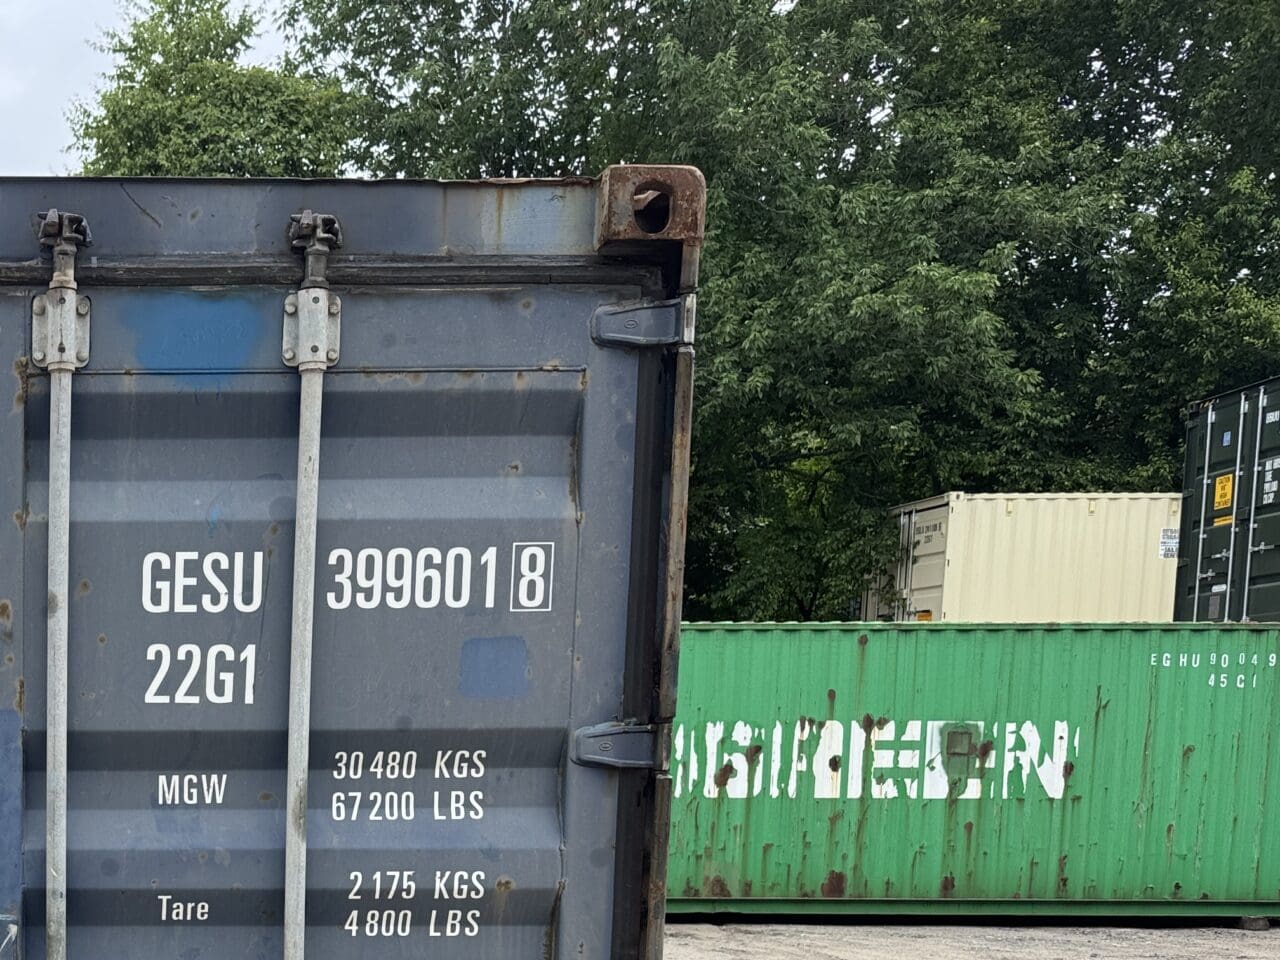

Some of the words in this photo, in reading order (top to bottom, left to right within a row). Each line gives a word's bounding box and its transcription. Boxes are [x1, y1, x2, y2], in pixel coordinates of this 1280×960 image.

[142, 551, 264, 613] GESU
[326, 546, 497, 610] 399601
[519, 546, 546, 607] 8
[144, 644, 257, 704] 22G1
[1150, 653, 1200, 668] EGHU
[158, 774, 227, 805] MGW
[434, 750, 487, 778] KGS
[434, 791, 484, 819] LBS
[158, 895, 209, 920] Tare
[434, 871, 486, 899] KGS
[429, 910, 480, 936] LBS
